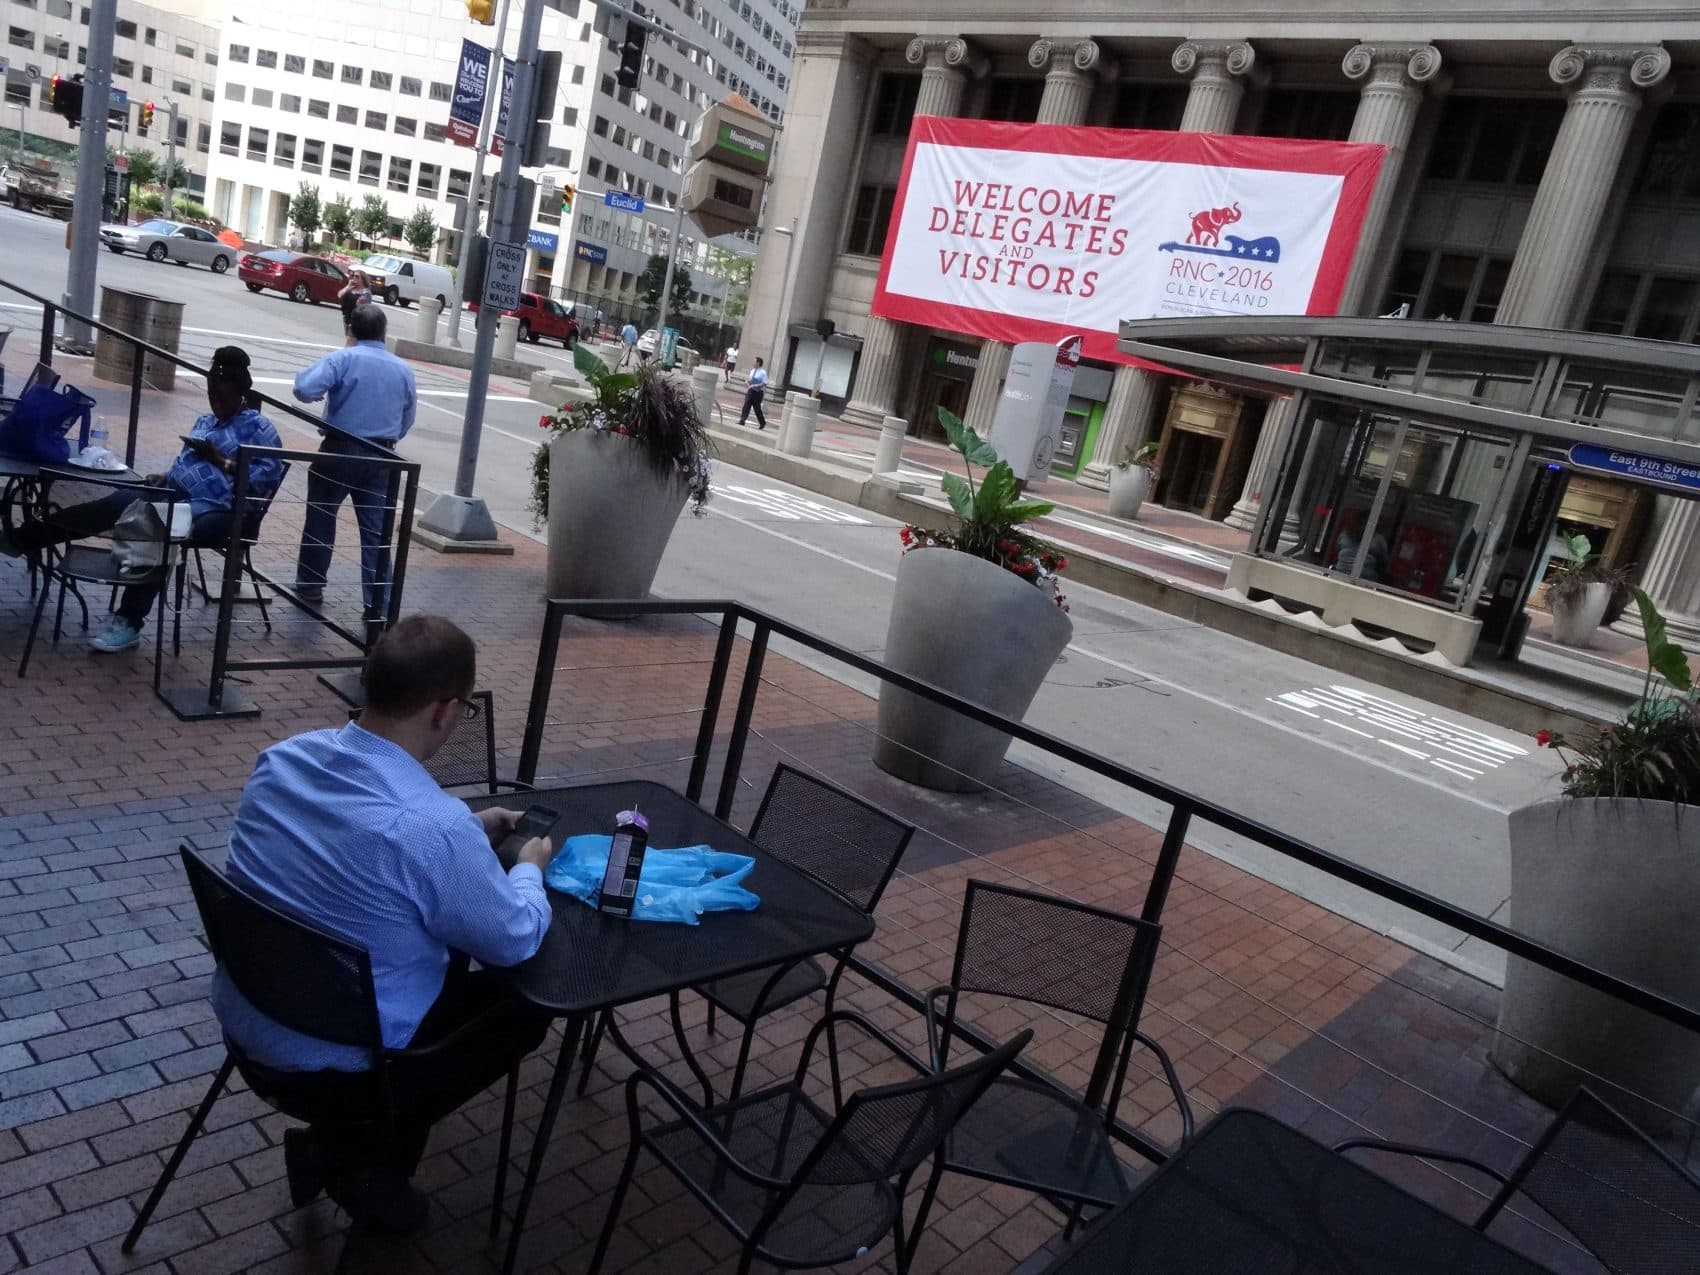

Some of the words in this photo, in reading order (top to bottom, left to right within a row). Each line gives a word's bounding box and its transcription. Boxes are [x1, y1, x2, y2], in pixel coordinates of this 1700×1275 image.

[464, 57, 487, 79] WE
[459, 82, 474, 93] YOU
[730, 129, 766, 151] Huntington
[611, 195, 638, 210] Euclid
[954, 180, 1116, 223] WELCOME
[928, 206, 1129, 256] DELEGATES
[531, 234, 553, 247] BANK
[495, 248, 521, 262] CROSS
[1000, 244, 1034, 260] AND
[496, 262, 517, 273] ONLY
[939, 249, 1099, 298] VISITORS
[1169, 258, 1217, 283] RNC
[1224, 266, 1273, 291] 2016
[490, 281, 516, 294] CROSS
[1166, 282, 1269, 308] CLEVELAND
[489, 293, 515, 306] WALKS
[1609, 452, 1638, 466] East
[1640, 458, 1660, 471] 9th
[1627, 465, 1678, 481] EASTBOUND
